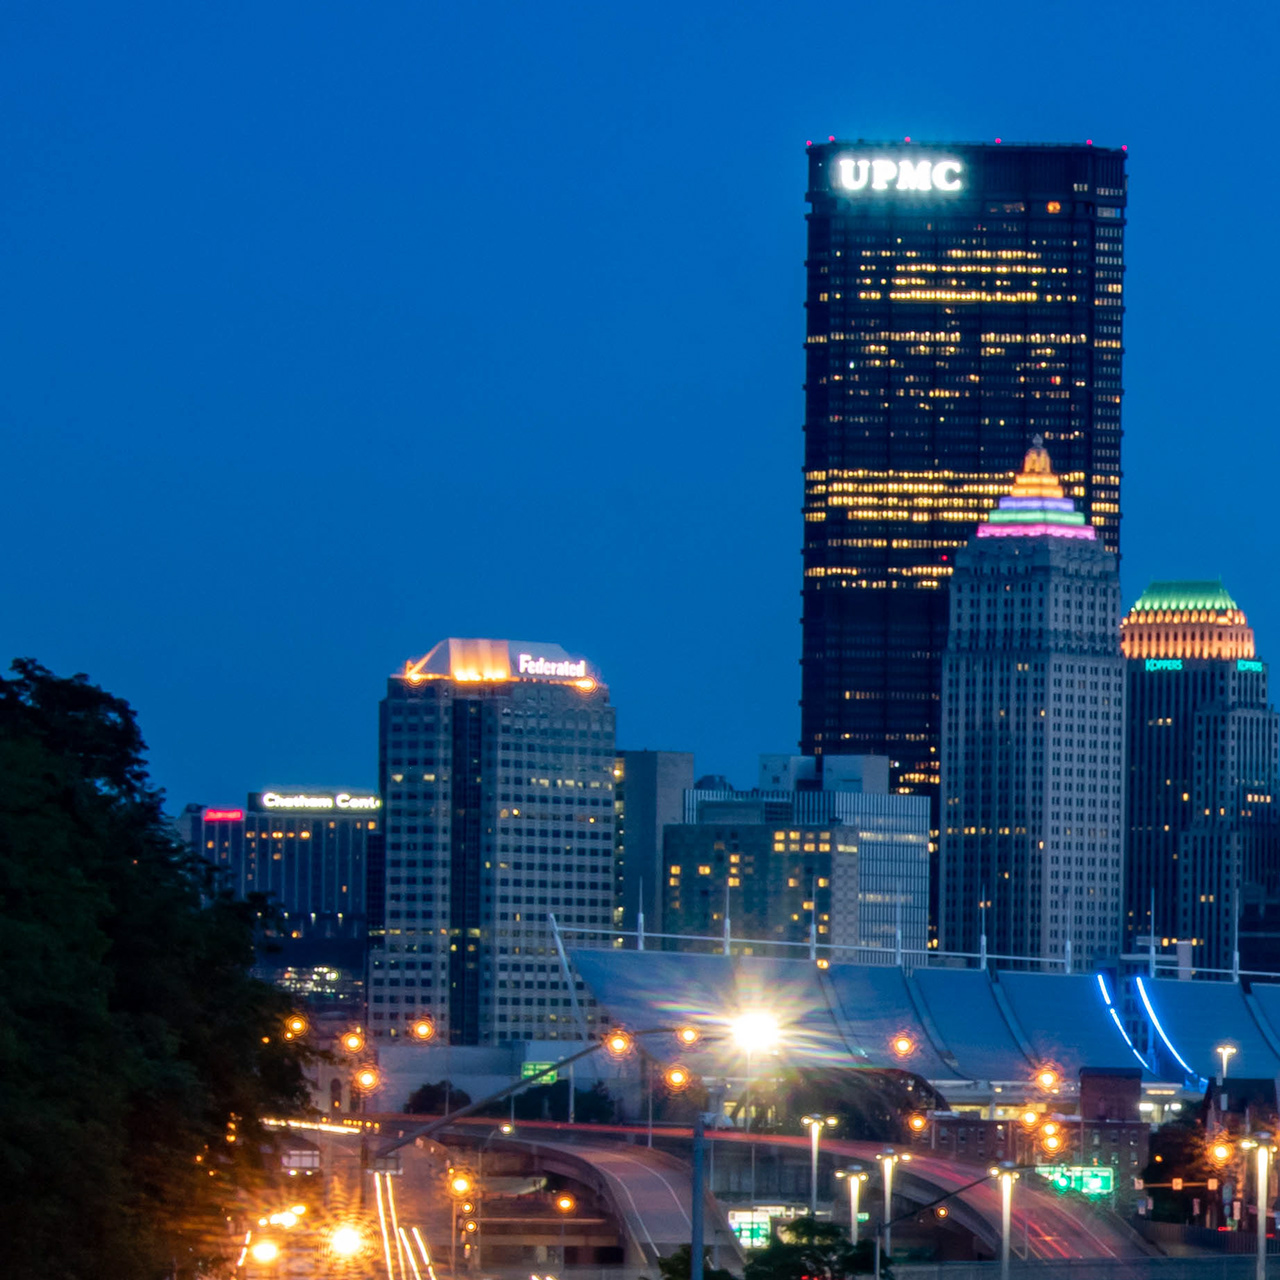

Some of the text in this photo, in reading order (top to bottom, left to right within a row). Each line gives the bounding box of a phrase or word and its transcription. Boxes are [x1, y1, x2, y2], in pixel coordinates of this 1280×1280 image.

[838, 158, 962, 192] UPMC
[519, 654, 585, 677] Federated
[263, 792, 333, 808] Chatham
